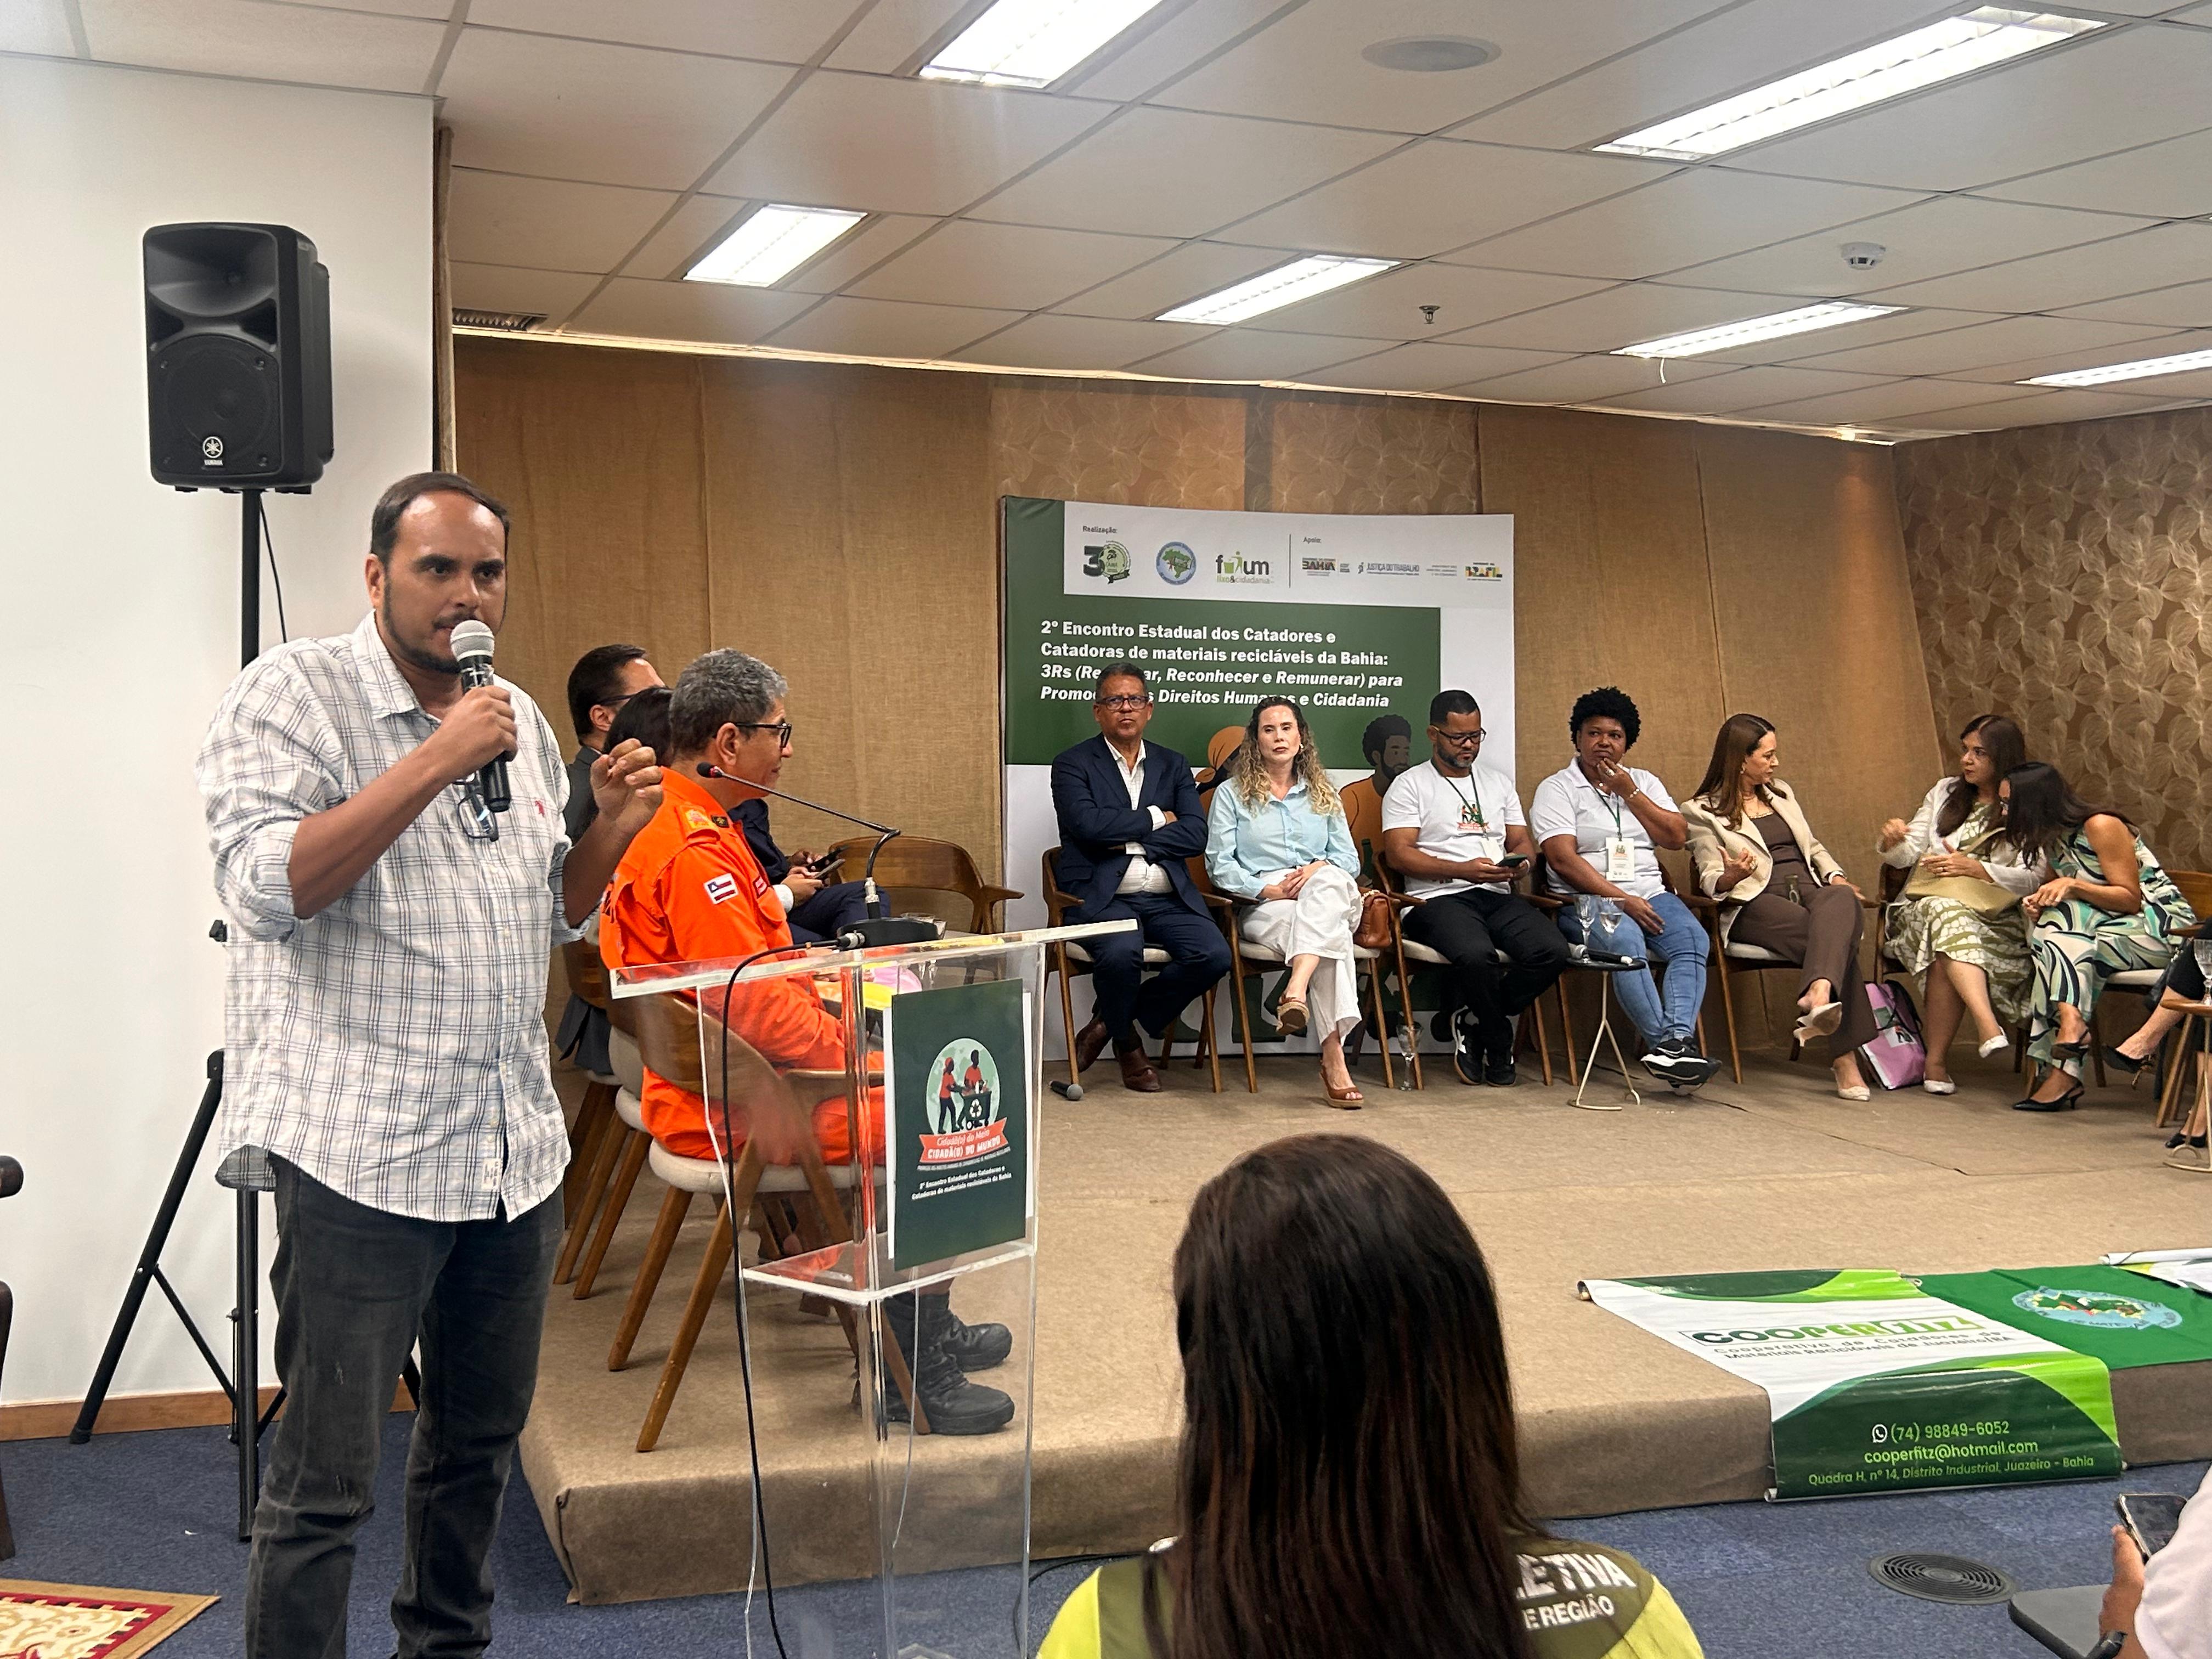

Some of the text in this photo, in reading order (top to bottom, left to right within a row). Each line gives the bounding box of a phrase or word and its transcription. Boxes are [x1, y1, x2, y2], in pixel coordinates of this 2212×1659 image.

[1041, 620, 1336, 644] 2º Encontro Estadual dos Catadores e
[1041, 642, 1389, 666] Catadoras de materiais recicláveis da Bahia:
[1041, 664, 1071, 679] 3Rs
[1166, 668, 1260, 684] Reconhecer
[1262, 673, 1273, 684] e
[1276, 671, 1365, 689] Remunerar)
[1368, 675, 1403, 689] para
[1158, 689, 1220, 704] Direitos
[1223, 691, 1296, 704] Humas
[1299, 695, 1310, 706] e
[1313, 692, 1390, 708] Cidadania
[966, 1144, 975, 1156] DO
[977, 1135, 1001, 1153] MUNDO
[1713, 1342, 1831, 1354] Cooperativa
[1874, 1334, 1969, 1344] Catadores
[1724, 1350, 1804, 1359] Materiais
[1891, 1420, 2010, 1444] (74) 98849-6052
[1864, 1440, 2039, 1465] cooperfitz@hotmail.com
[1809, 1472, 1853, 1486] Quadra
[1870, 1469, 1883, 1481] nº
[1903, 1465, 1943, 1479] Distrito
[1946, 1461, 2002, 1476] Industrial,
[2004, 1458, 2051, 1472] Juazeiro
[2062, 1455, 2095, 1468] Bahia
[1516, 1553, 1638, 1600] ETIVA
[1538, 1593, 1615, 1628] REGIÃO
